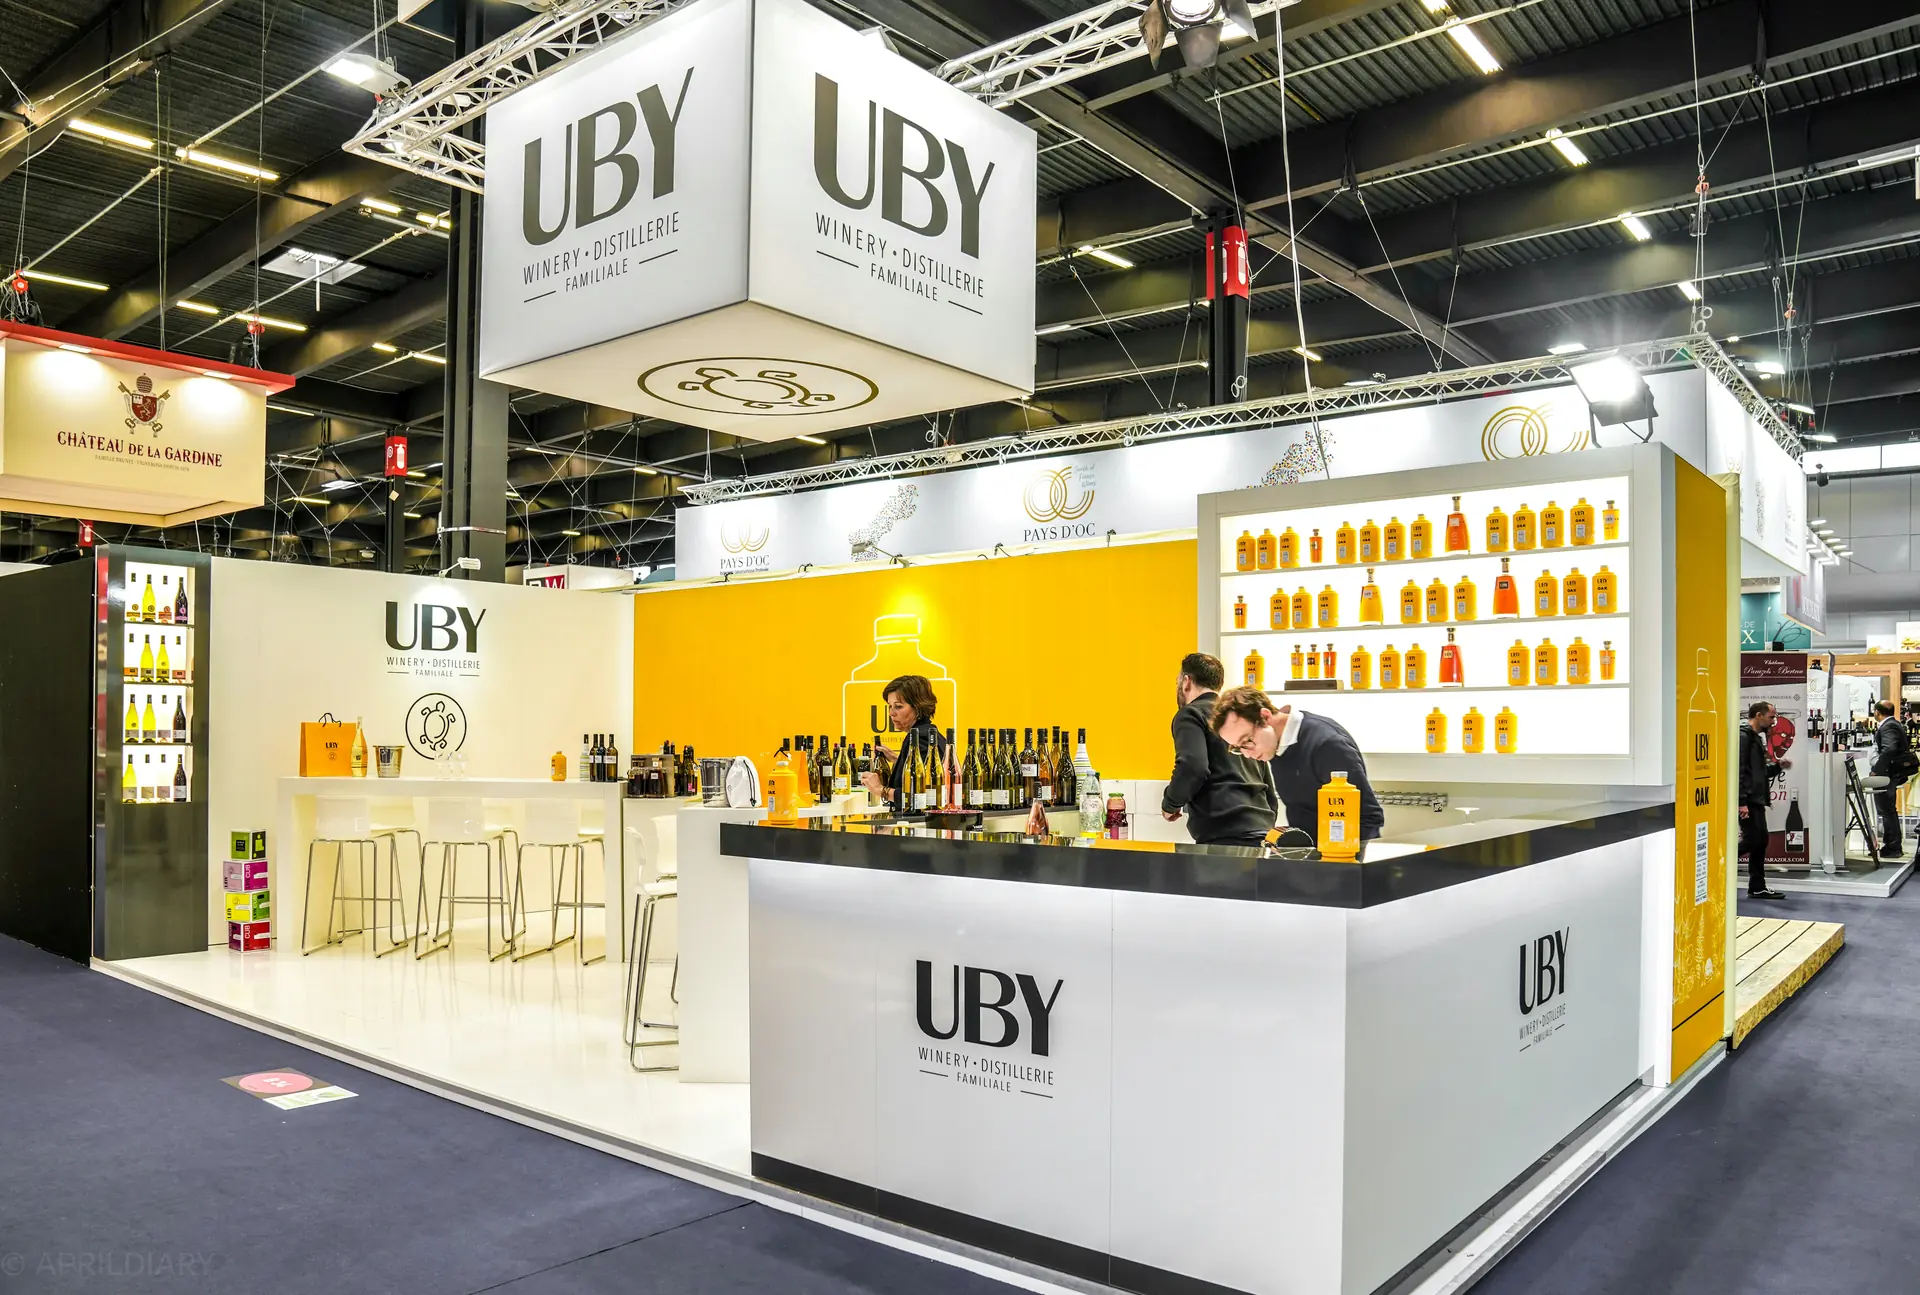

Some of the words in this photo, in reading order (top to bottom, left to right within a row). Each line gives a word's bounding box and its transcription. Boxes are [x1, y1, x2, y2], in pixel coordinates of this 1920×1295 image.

[522, 67, 694, 246] UBY
[814, 72, 995, 259] UBY
[524, 248, 580, 285] WINERY
[594, 211, 680, 261] DISTILLERIE
[816, 212, 888, 258] WINERY
[902, 248, 984, 298] DISTILLERIE
[565, 257, 628, 292] FAMILIALE
[870, 262, 938, 302] FAMILIALE
[57, 430, 124, 453] CHÂTEAU
[128, 443, 144, 456] DE
[147, 445, 160, 458] LA
[164, 446, 223, 467] GARDINE
[1024, 526, 1057, 542] PAYS
[1062, 522, 1096, 538] D'OC
[720, 556, 744, 569] PAYS
[746, 555, 770, 567] D'OC
[386, 601, 486, 653] UBY
[386, 657, 425, 666] WINERY
[432, 659, 480, 669] DISTILLERIE
[1695, 734, 1710, 762] UBY
[1695, 786, 1710, 807] OAK
[1519, 926, 1569, 1015] UBY
[916, 960, 1064, 1057] UBY
[1519, 1018, 1539, 1040] WINERY
[918, 1047, 969, 1068] WINERY
[981, 1058, 1054, 1085] DISTILLERIE
[957, 1072, 1011, 1092] FAMILIALE
